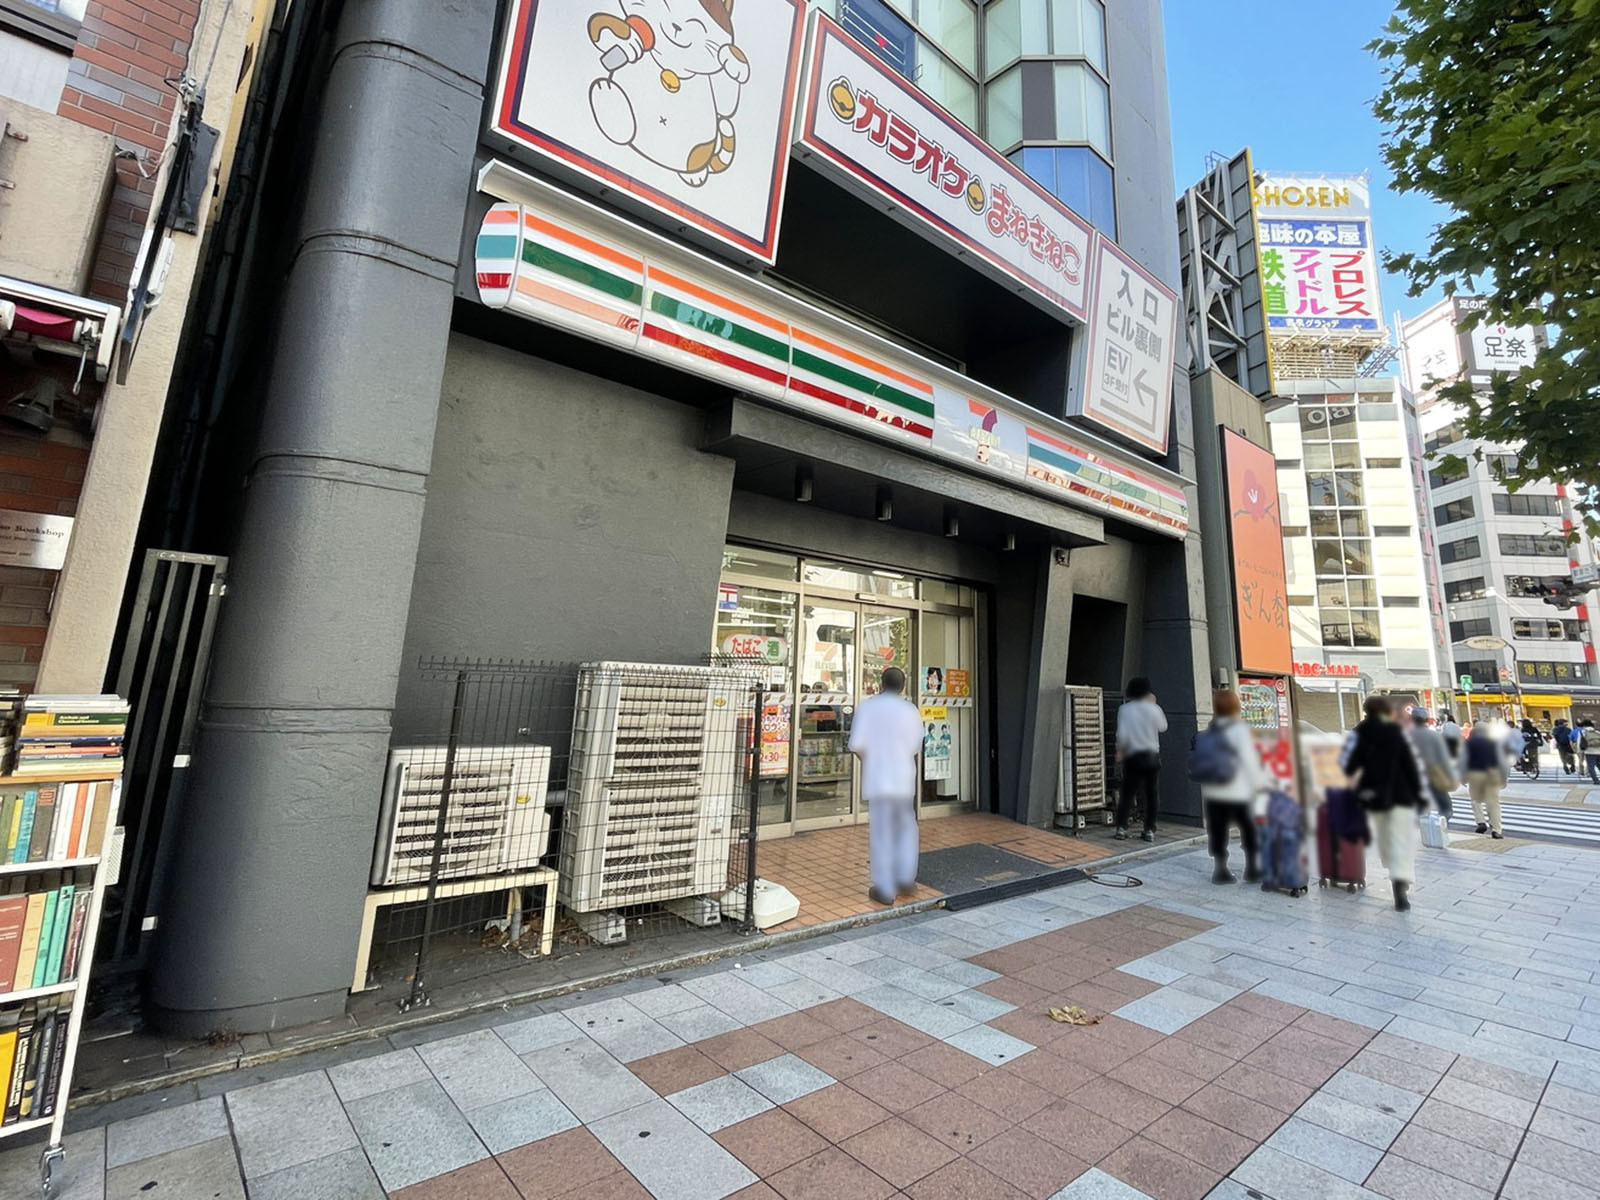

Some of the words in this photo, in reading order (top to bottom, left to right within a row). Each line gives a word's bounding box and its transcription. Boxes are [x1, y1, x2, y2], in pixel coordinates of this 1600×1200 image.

[853, 92, 969, 198] カラオケ
[985, 183, 1081, 285] まねきねこ
[1252, 185, 1350, 207] SHOSEN
[1116, 268, 1159, 326] 入口
[1289, 248, 1329, 315] アイドル
[1329, 249, 1372, 317] プロレス
[1106, 303, 1162, 363] ビル裏側
[1484, 336, 1528, 358] 足楽
[1107, 346, 1129, 375] EV
[731, 638, 761, 654] たばこ
[767, 640, 780, 657] 酒
[1293, 663, 1359, 677] ABC-MART
